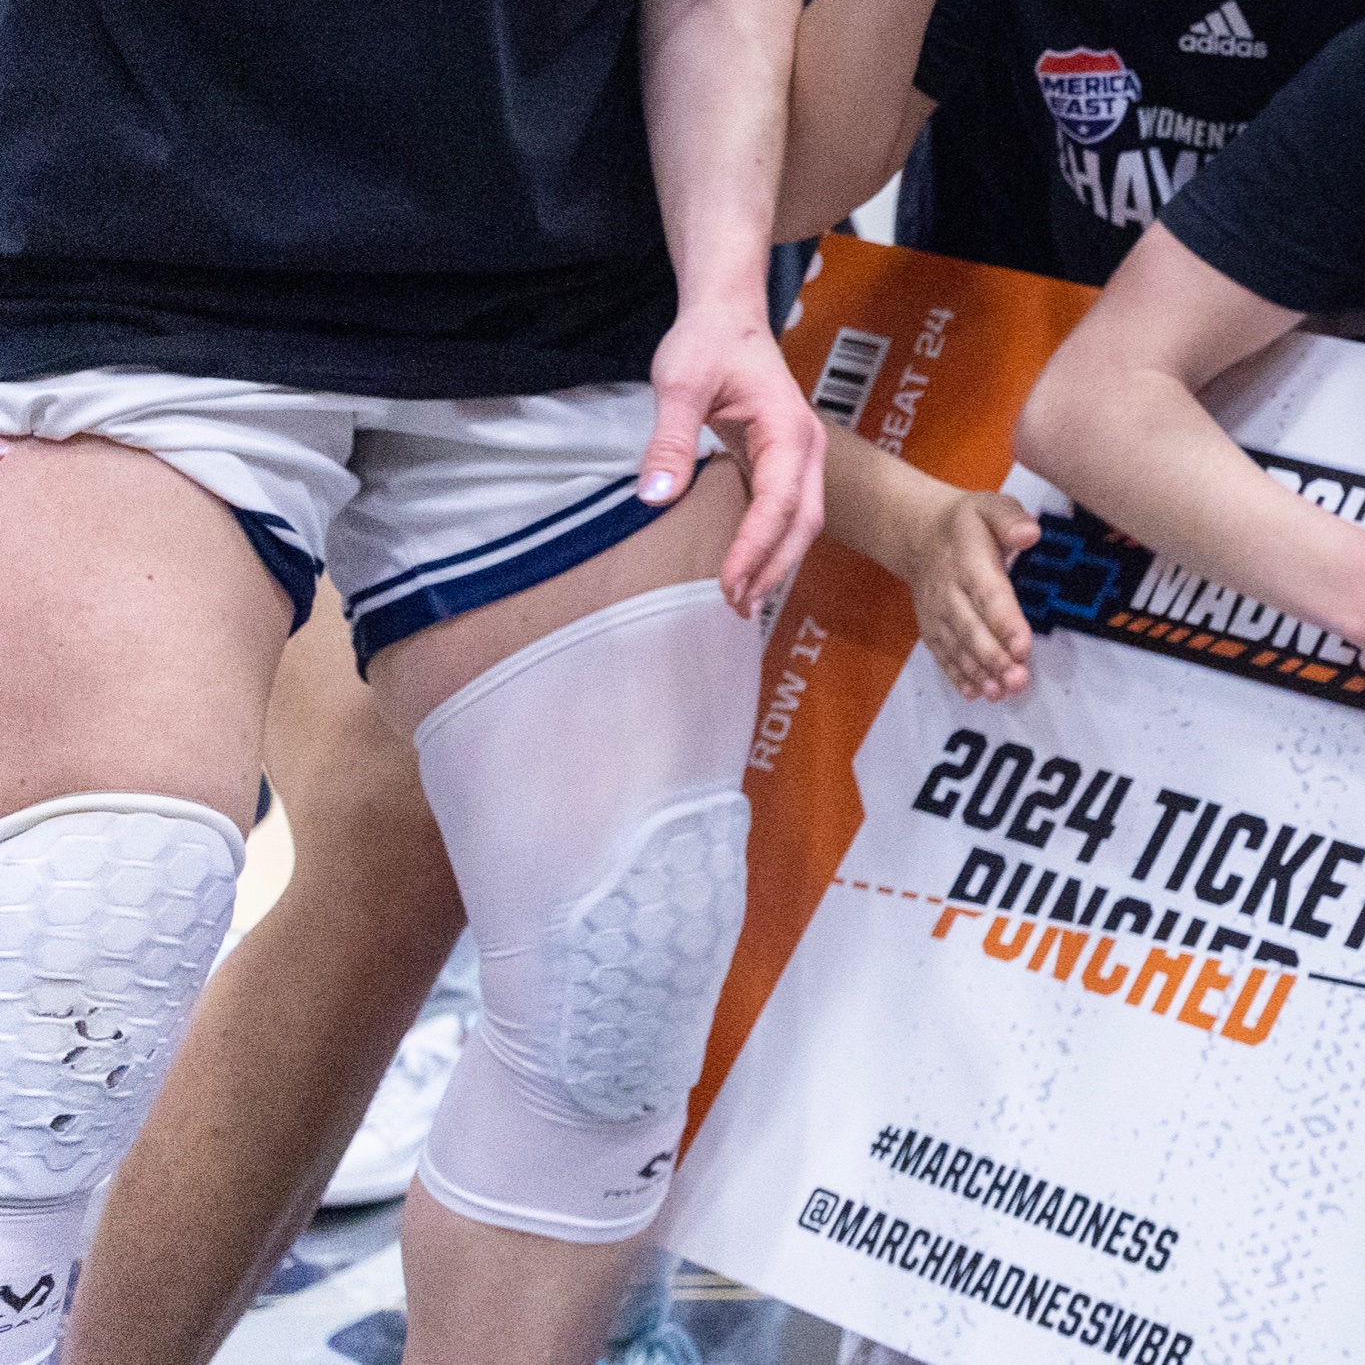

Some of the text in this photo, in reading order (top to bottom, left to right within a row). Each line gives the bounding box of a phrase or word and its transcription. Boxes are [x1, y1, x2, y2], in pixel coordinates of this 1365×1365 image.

[1041, 74, 1142, 98] MERICA
[1178, 35, 1268, 60] adidas
[878, 307, 955, 461] SEAT 24
[748, 614, 829, 771] ROW 17
[911, 727, 1134, 864] 2024
[930, 845, 1300, 1047] PUNCHED
[870, 1124, 1180, 1273] #MARCHMADNESS
